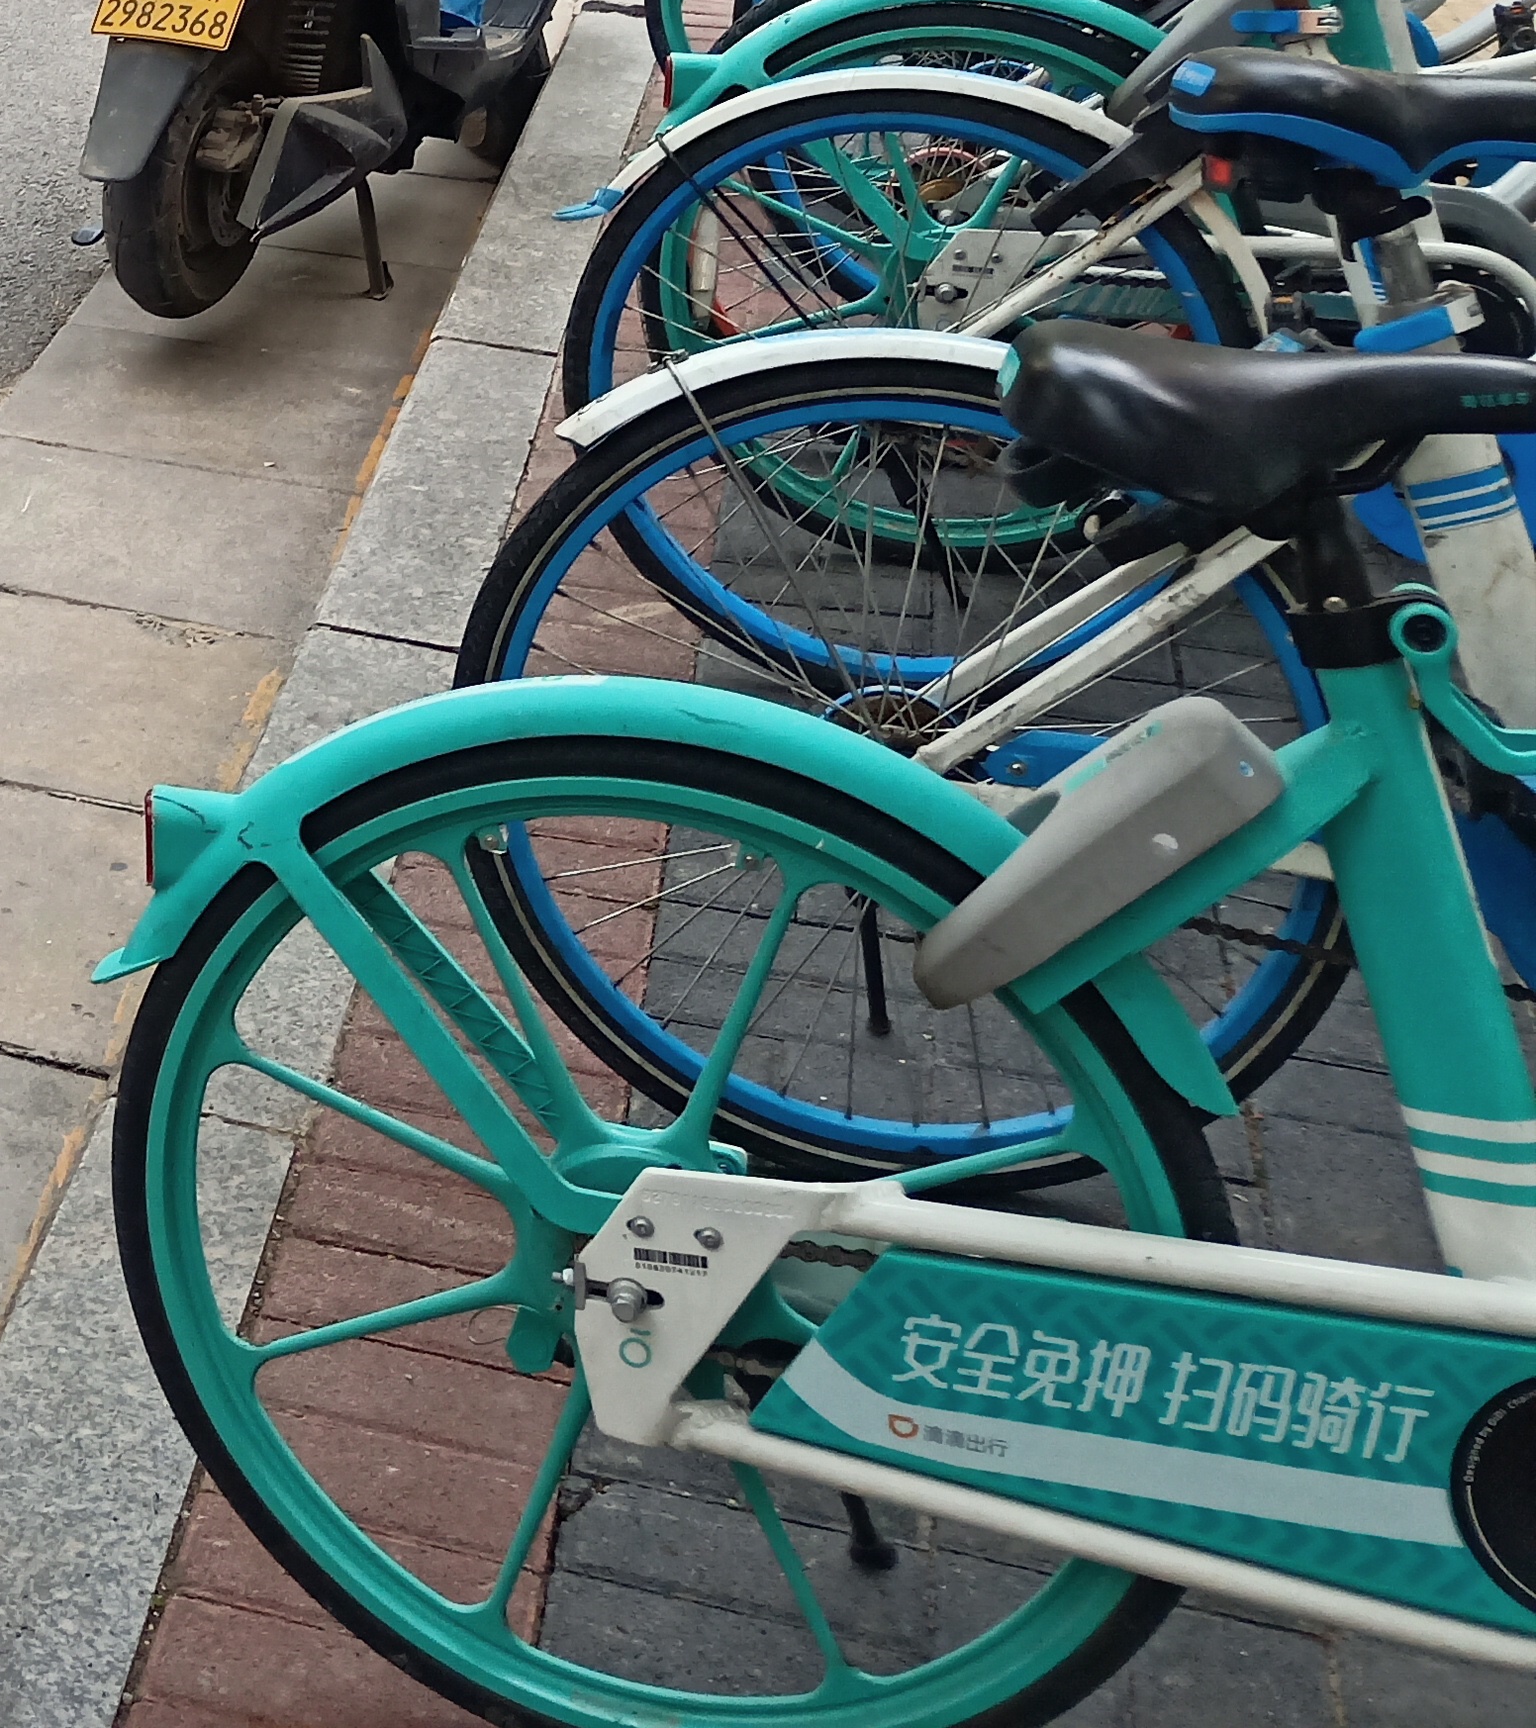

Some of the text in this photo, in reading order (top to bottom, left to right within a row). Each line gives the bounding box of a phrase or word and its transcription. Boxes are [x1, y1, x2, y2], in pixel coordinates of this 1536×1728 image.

[891, 1313, 1435, 1463] 安全免押 扫码骑行
[923, 1424, 1009, 1458] 滴滴出行
